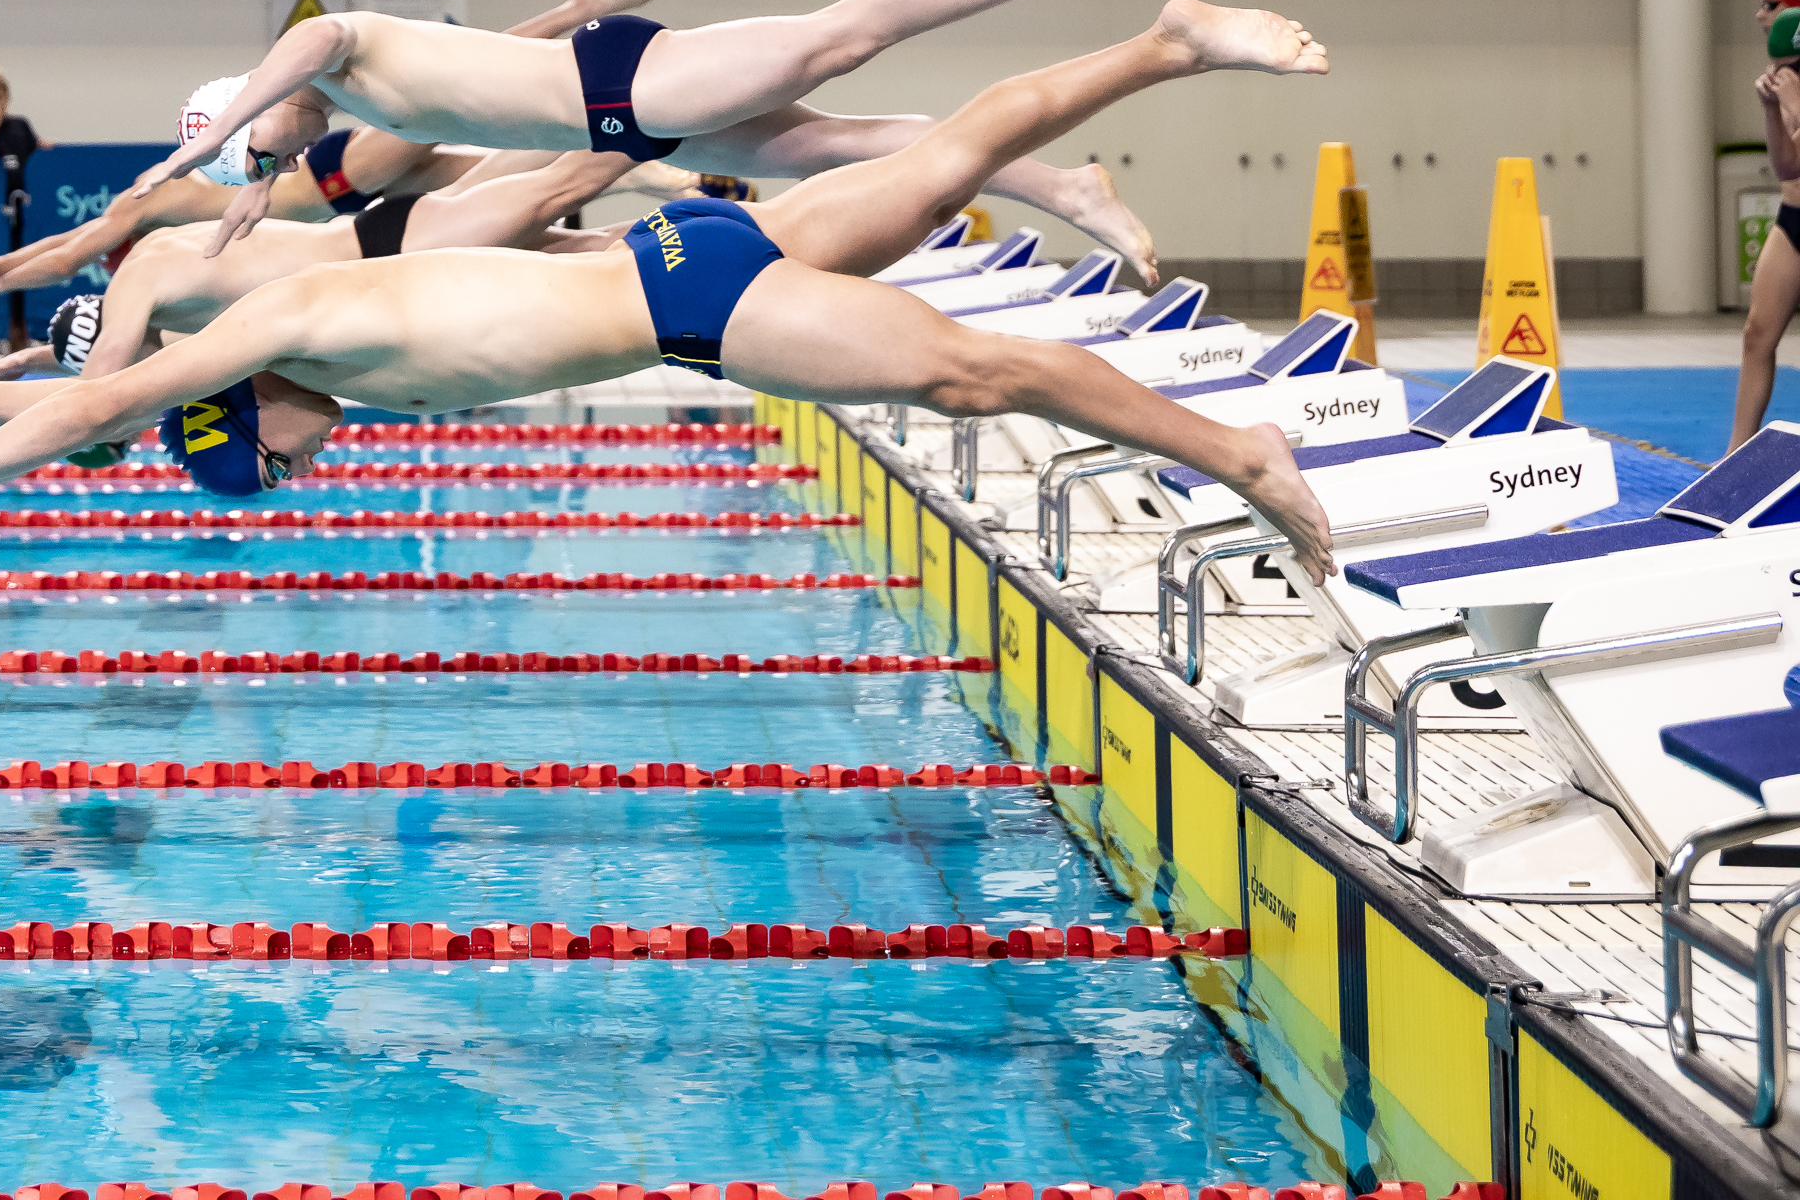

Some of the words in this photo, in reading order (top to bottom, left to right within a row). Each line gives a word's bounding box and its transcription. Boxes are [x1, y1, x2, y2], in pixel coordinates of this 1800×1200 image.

[61, 297, 100, 375] KNOX
[1179, 346, 1244, 373] Sydney
[182, 401, 228, 455] W
[1304, 398, 1380, 426] Sydney
[1489, 463, 1583, 498] Sydney
